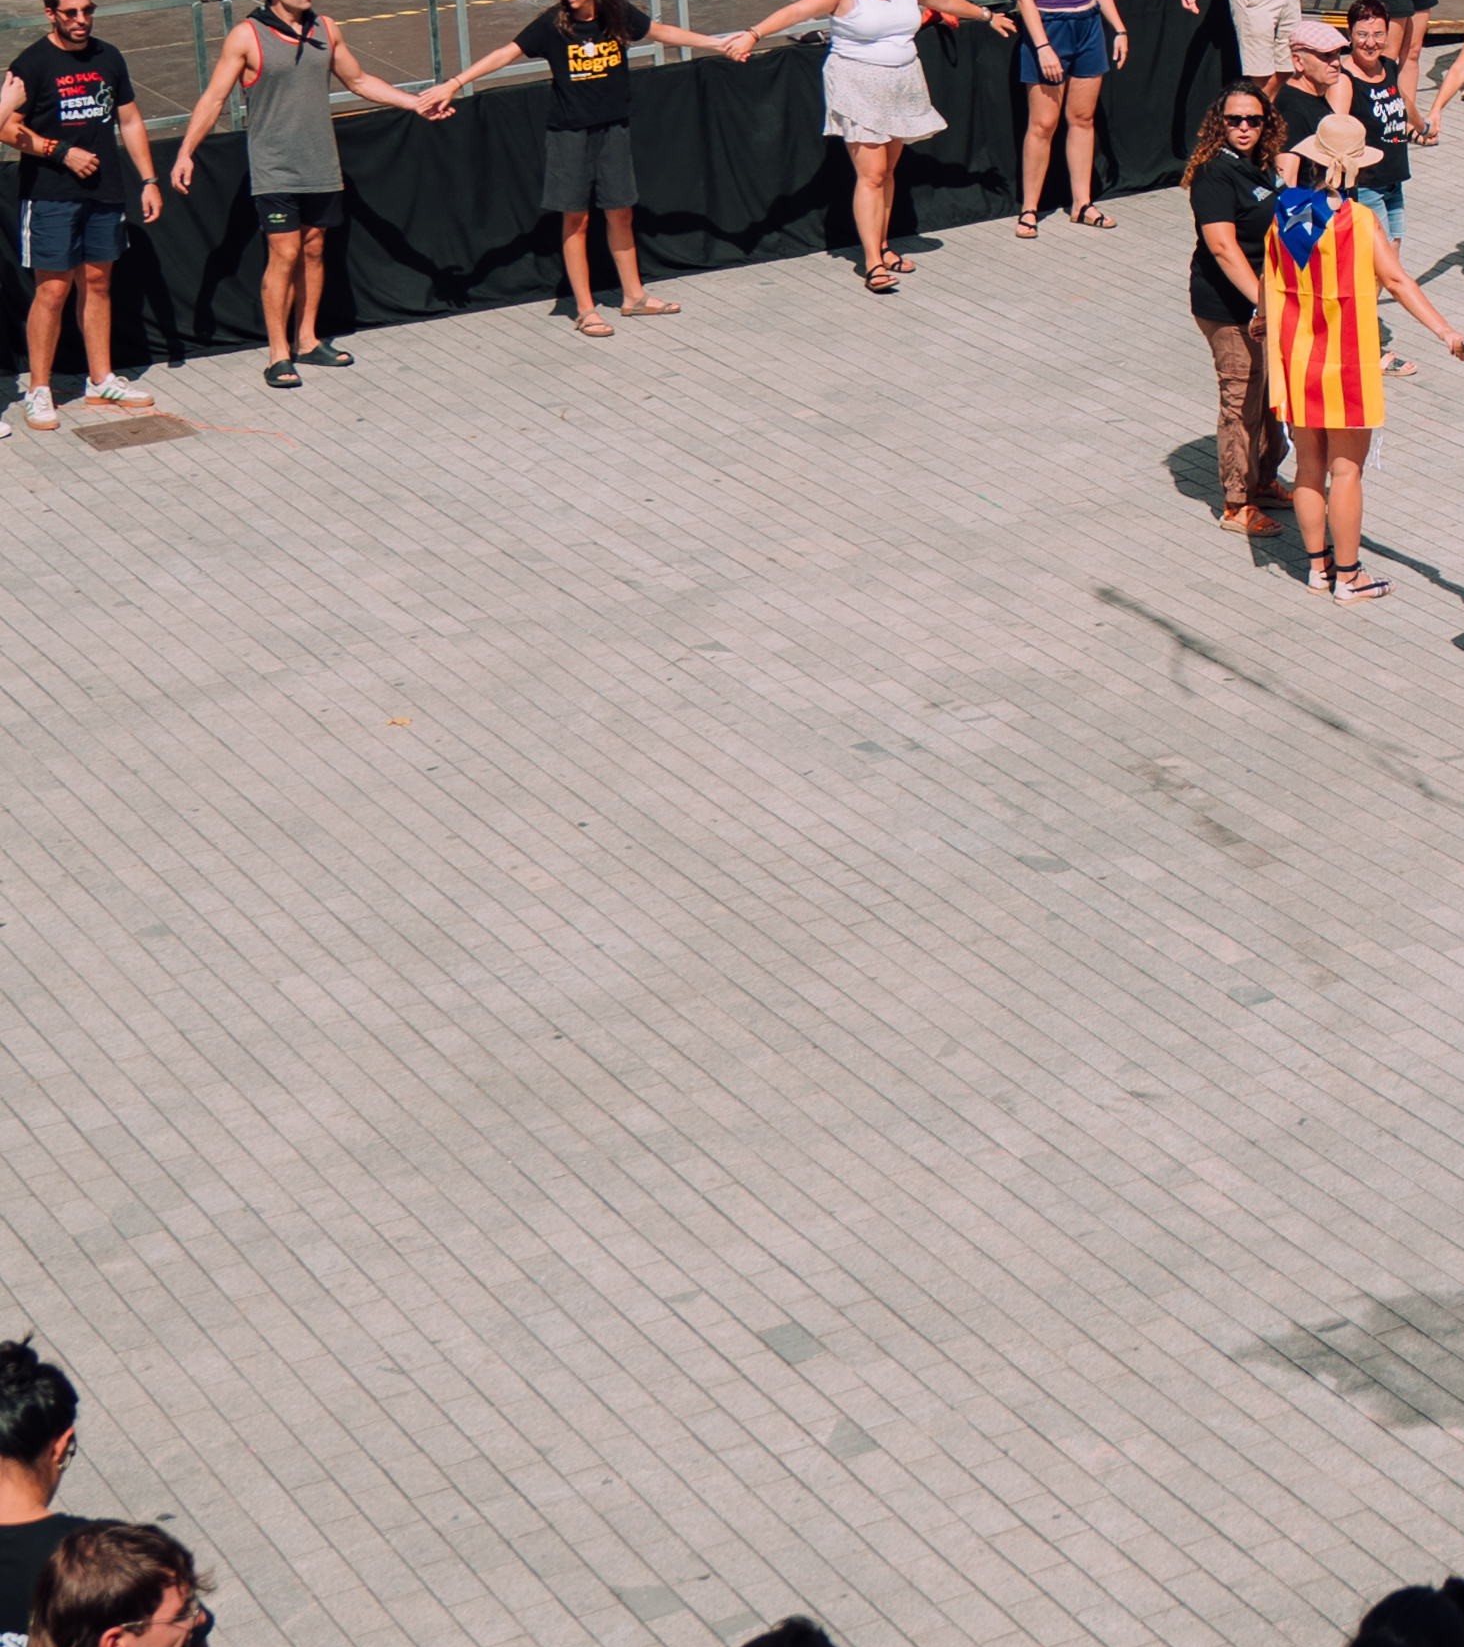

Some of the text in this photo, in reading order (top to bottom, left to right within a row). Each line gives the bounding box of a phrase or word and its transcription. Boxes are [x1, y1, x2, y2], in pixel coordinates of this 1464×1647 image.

[567, 39, 620, 59] Força
[568, 50, 622, 72] Negra!
[56, 75, 75, 87] NO
[58, 84, 87, 97] TINC
[60, 95, 96, 109] FESTA
[60, 106, 104, 120] MAJOR!
